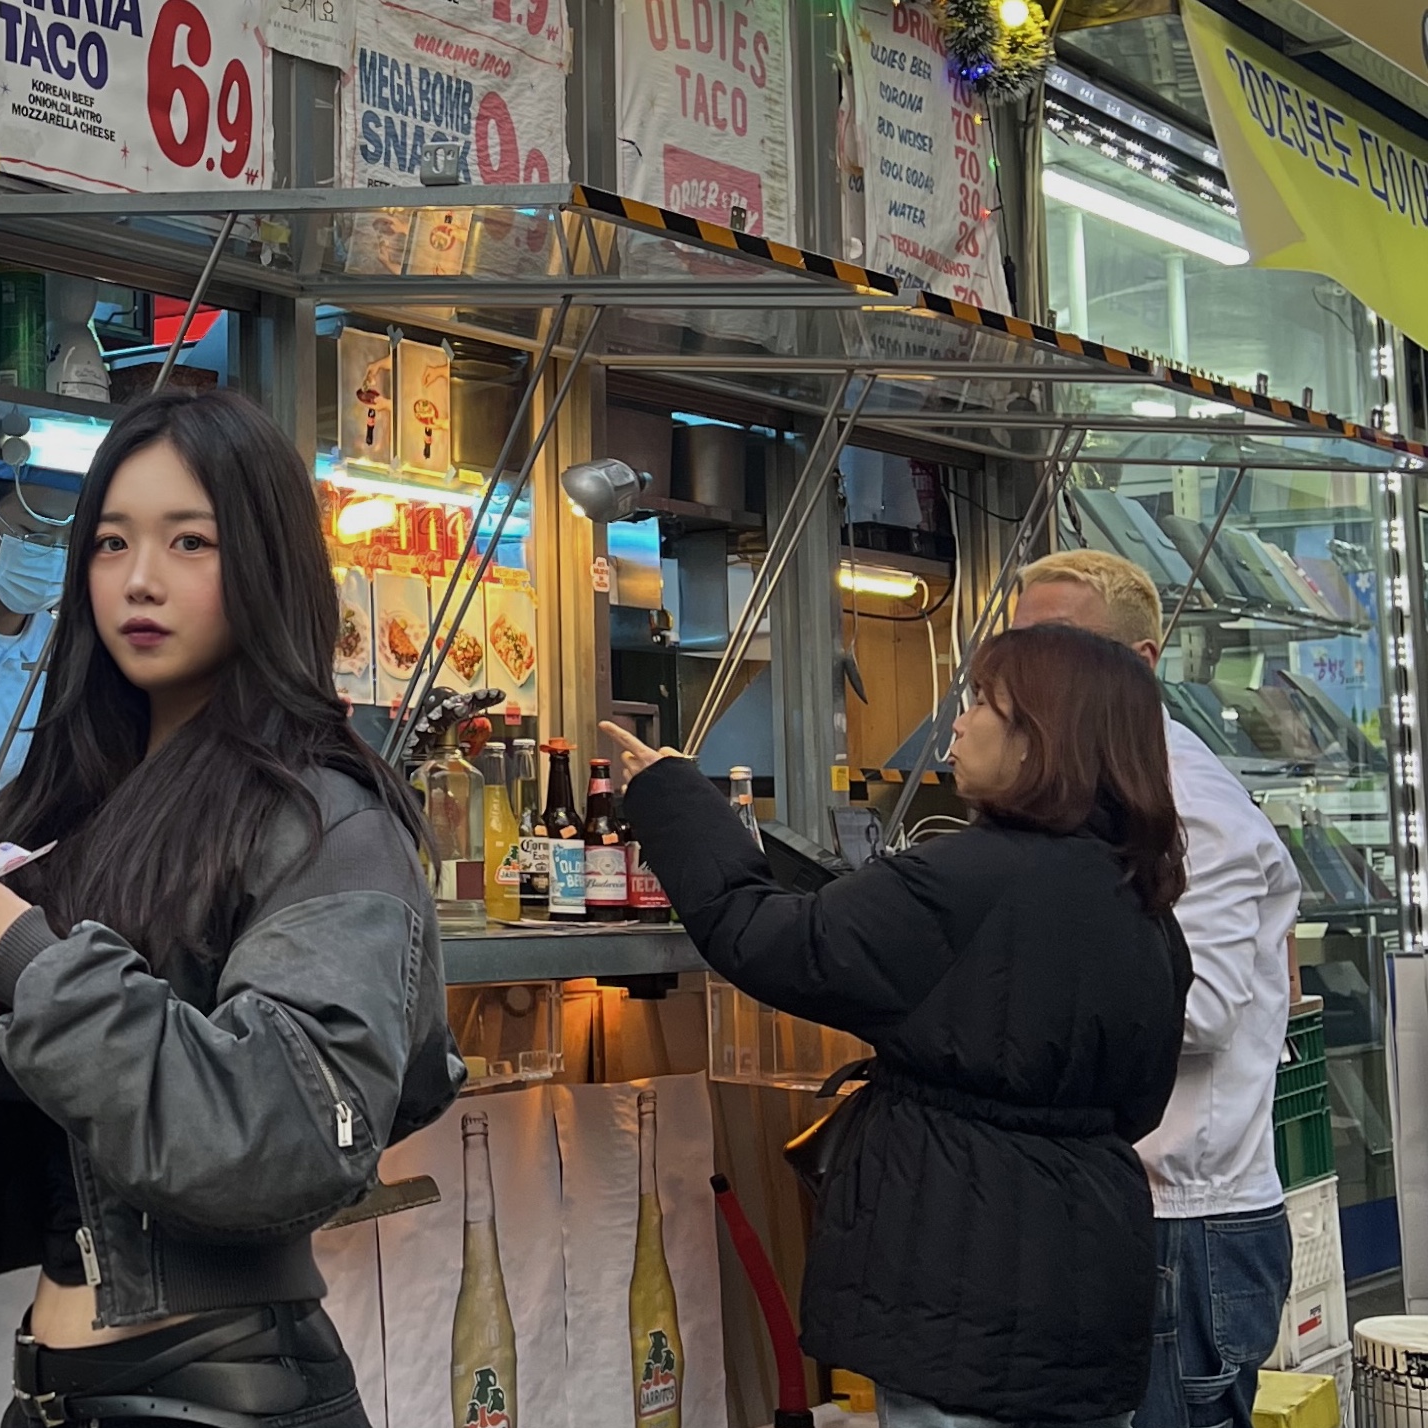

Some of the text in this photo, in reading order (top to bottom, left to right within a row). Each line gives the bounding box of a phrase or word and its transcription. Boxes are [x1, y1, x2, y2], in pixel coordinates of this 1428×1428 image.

[0, 1, 108, 90] TACO
[414, 32, 512, 79] WALKING TACO
[645, 0, 770, 89] OLDIES
[870, 41, 932, 82] OLDIES BEER
[31, 78, 95, 108] KOREAN BEEF
[358, 47, 473, 136] MEGA BOMB
[675, 64, 748, 137] TACO
[879, 81, 924, 114] CORONA
[11, 102, 116, 142] MOZZARELLA CHEESE
[877, 116, 934, 155] BUD WEISER
[1226, 48, 1360, 188] 2025년도
[880, 156, 903, 182] COOL
[669, 178, 720, 212] ORDER
[888, 200, 926, 228] WATER
[641, 1385, 676, 1409] JARRITOS
